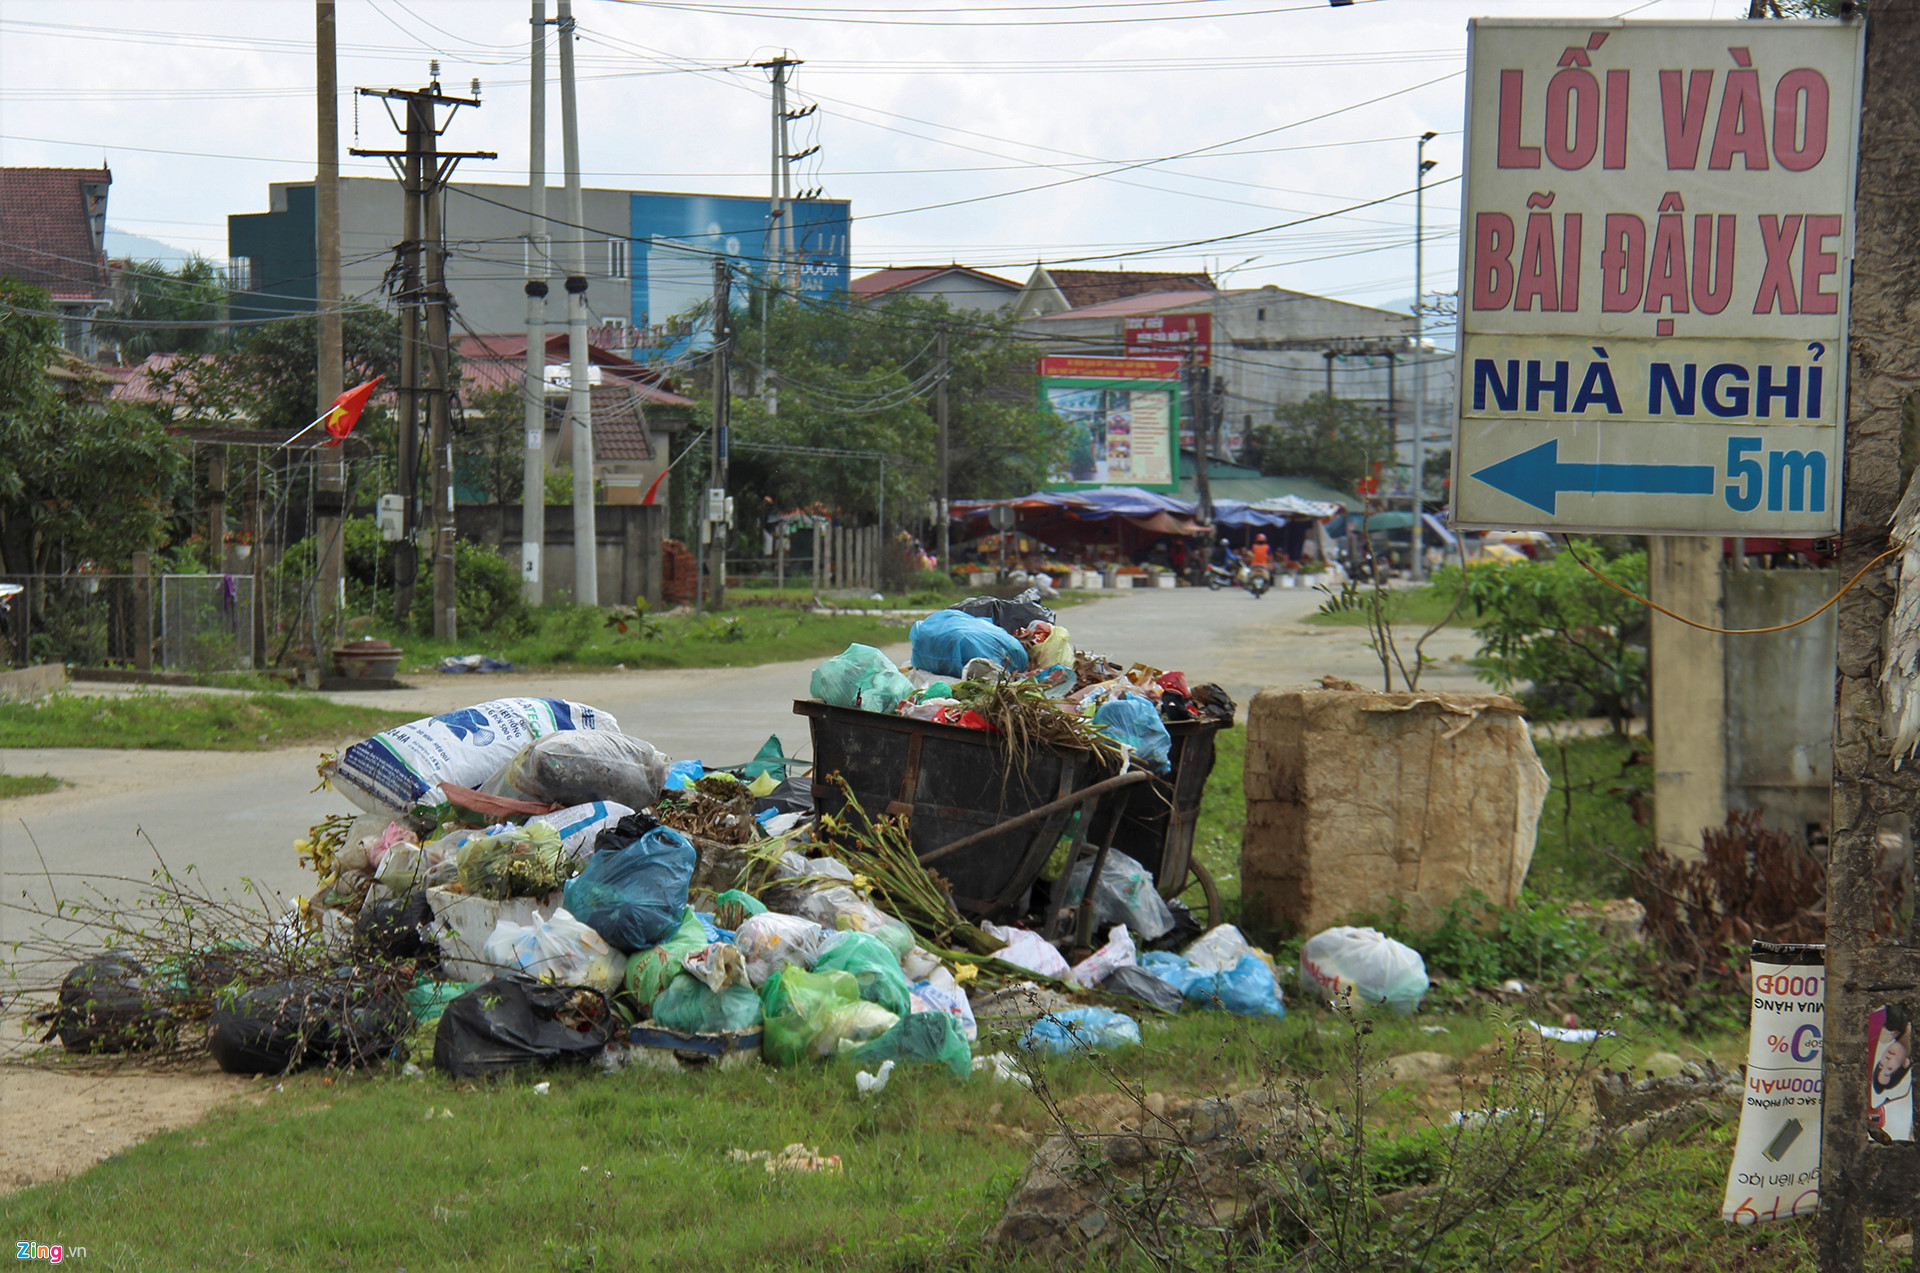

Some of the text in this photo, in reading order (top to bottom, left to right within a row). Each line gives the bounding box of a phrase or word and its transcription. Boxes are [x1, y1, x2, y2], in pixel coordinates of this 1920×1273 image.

[1497, 32, 1830, 172] LỐI VÀO
[1472, 190, 1842, 337] BÃI ĐẬU XE
[1472, 341, 1826, 419] NHÀ NGHỈ
[1724, 436, 1827, 513] 5m
[1754, 998, 1825, 1015] MUA HÀNG
[1747, 1096, 1781, 1111] PHÒNG
[1796, 1096, 1817, 1106] SẠC
[1738, 1172, 1765, 1189] lạc
[1769, 1173, 1794, 1188] liên
